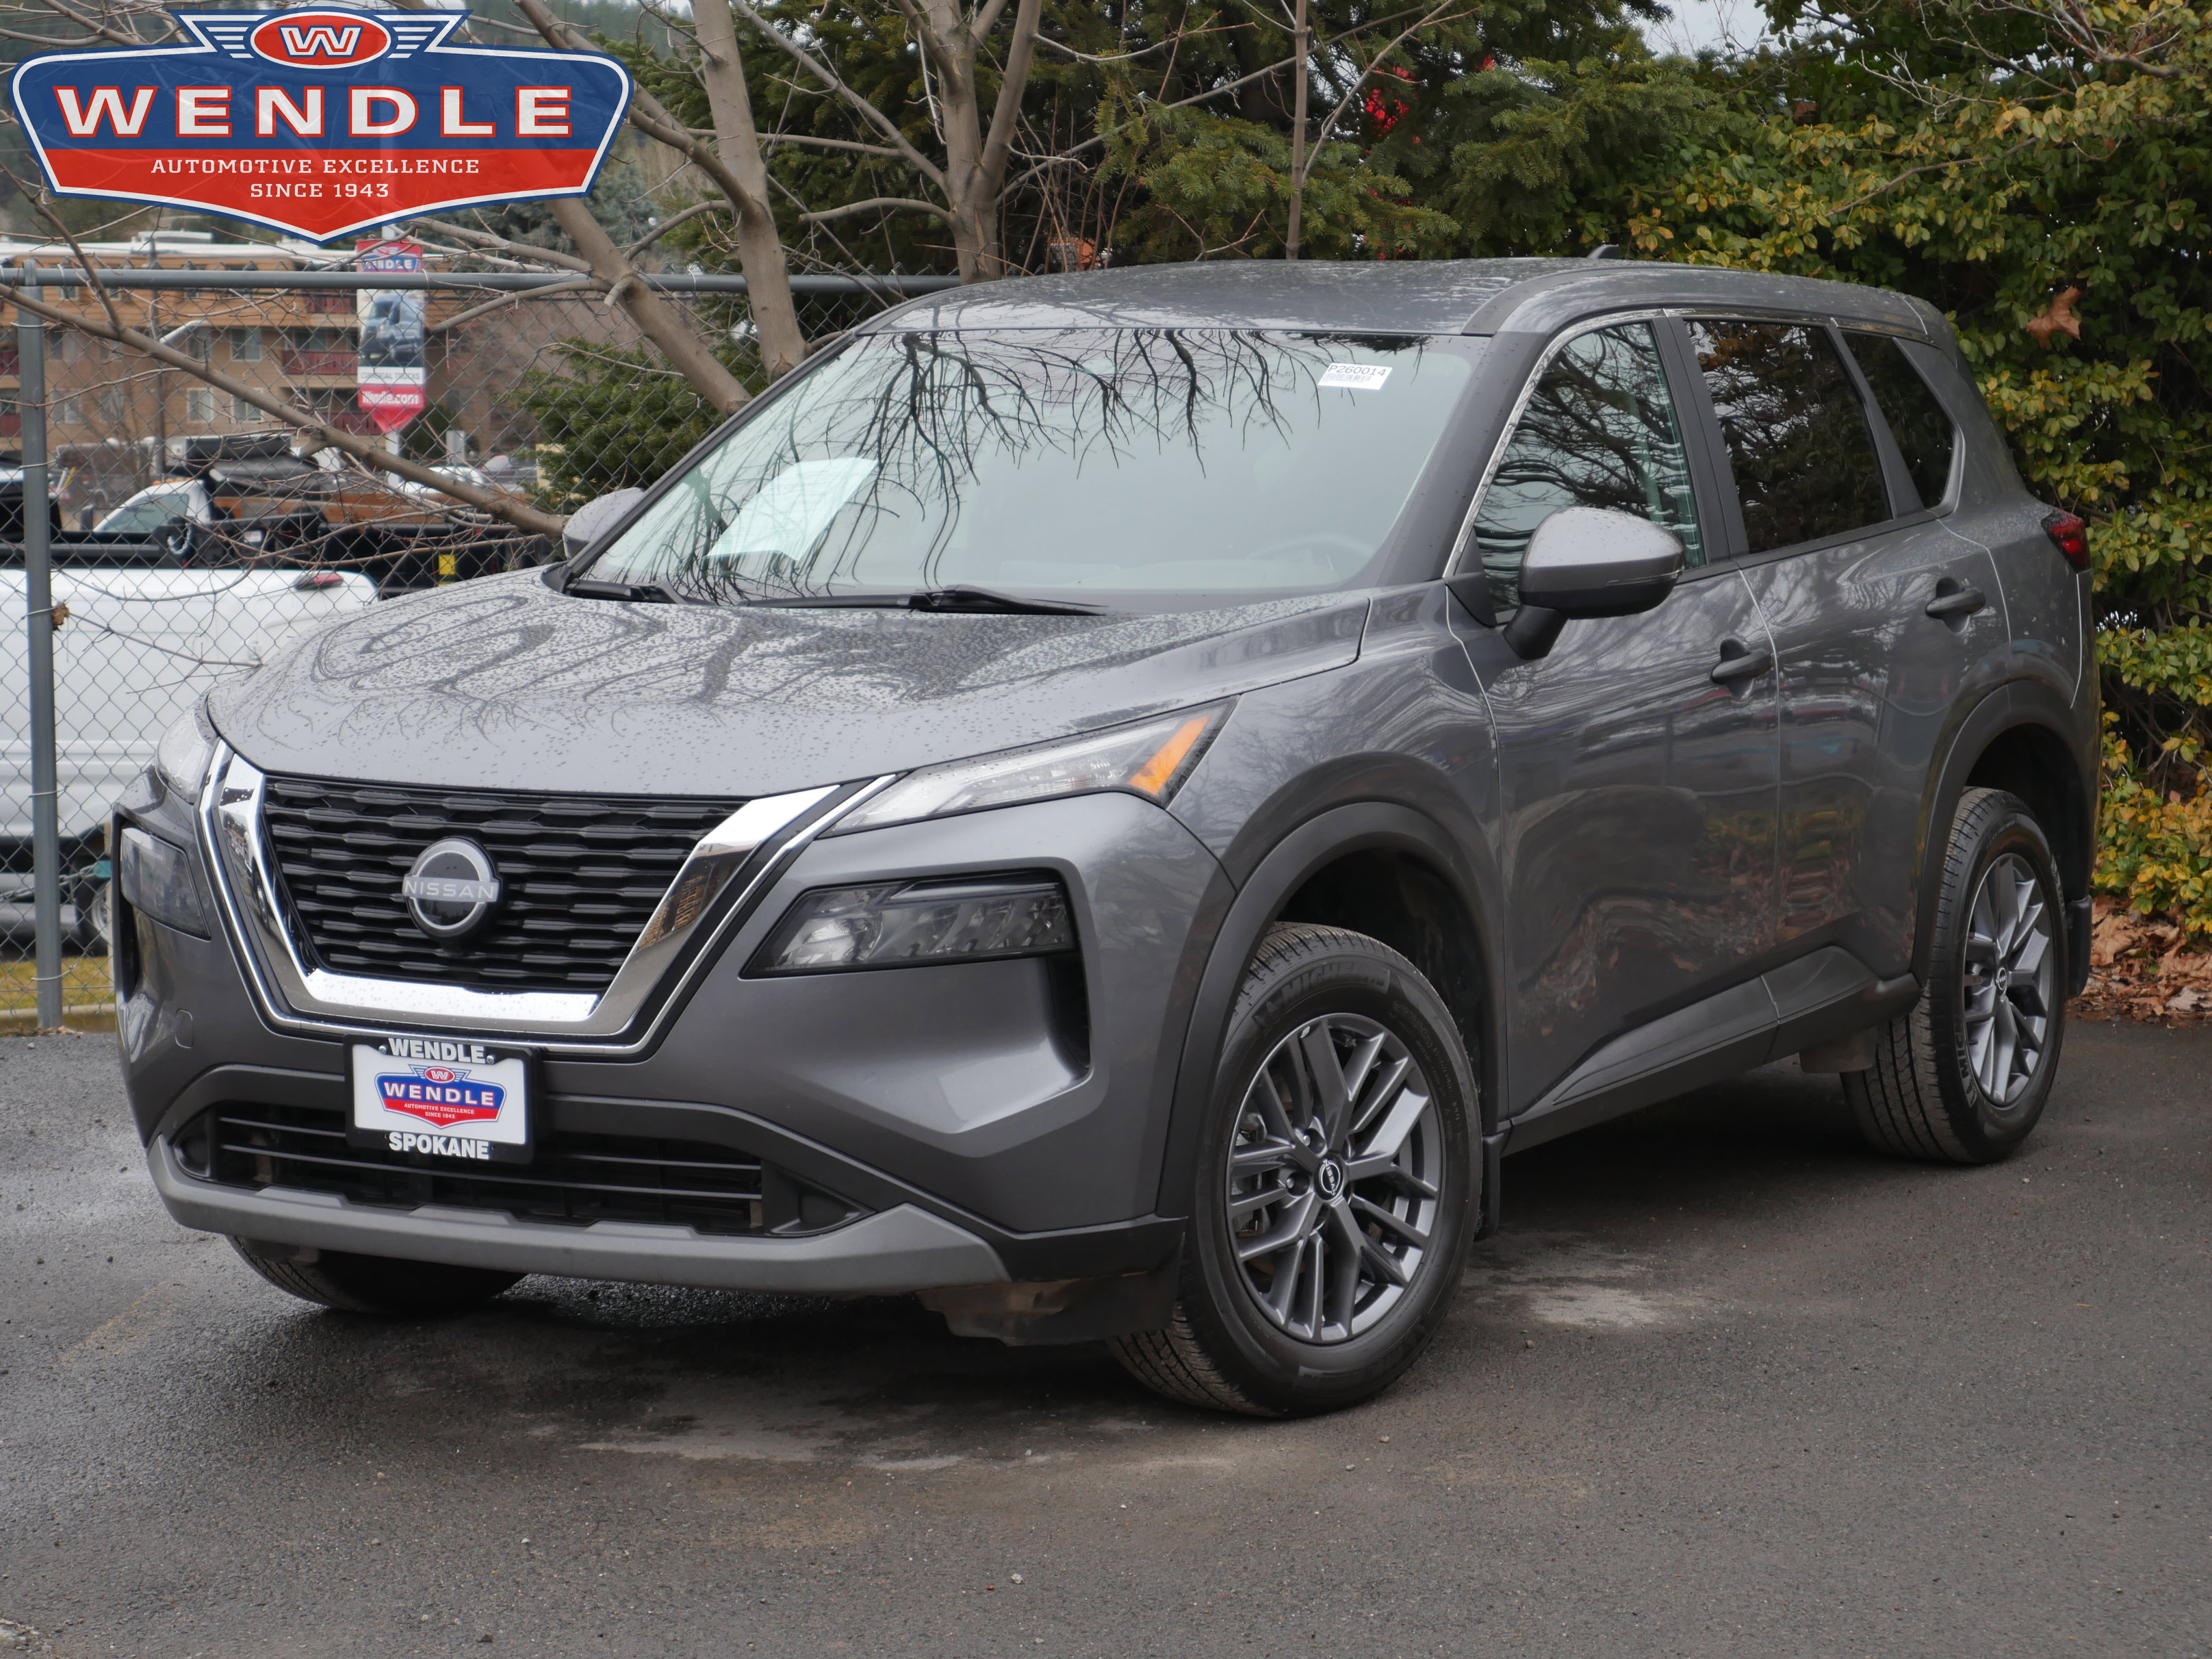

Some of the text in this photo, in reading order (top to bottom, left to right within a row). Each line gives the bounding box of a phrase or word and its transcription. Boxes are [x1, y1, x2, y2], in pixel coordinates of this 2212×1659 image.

[1328, 364, 1387, 376] P260014
[404, 880, 494, 899] NISSAN
[1282, 961, 1385, 1005] MICHE
[388, 1038, 486, 1064] WENDLE
[383, 1082, 494, 1106] WENDLE
[404, 1103, 474, 1114] AUTOMOTIVE EXCELLENCE
[389, 1131, 489, 1159] SPOKANE
